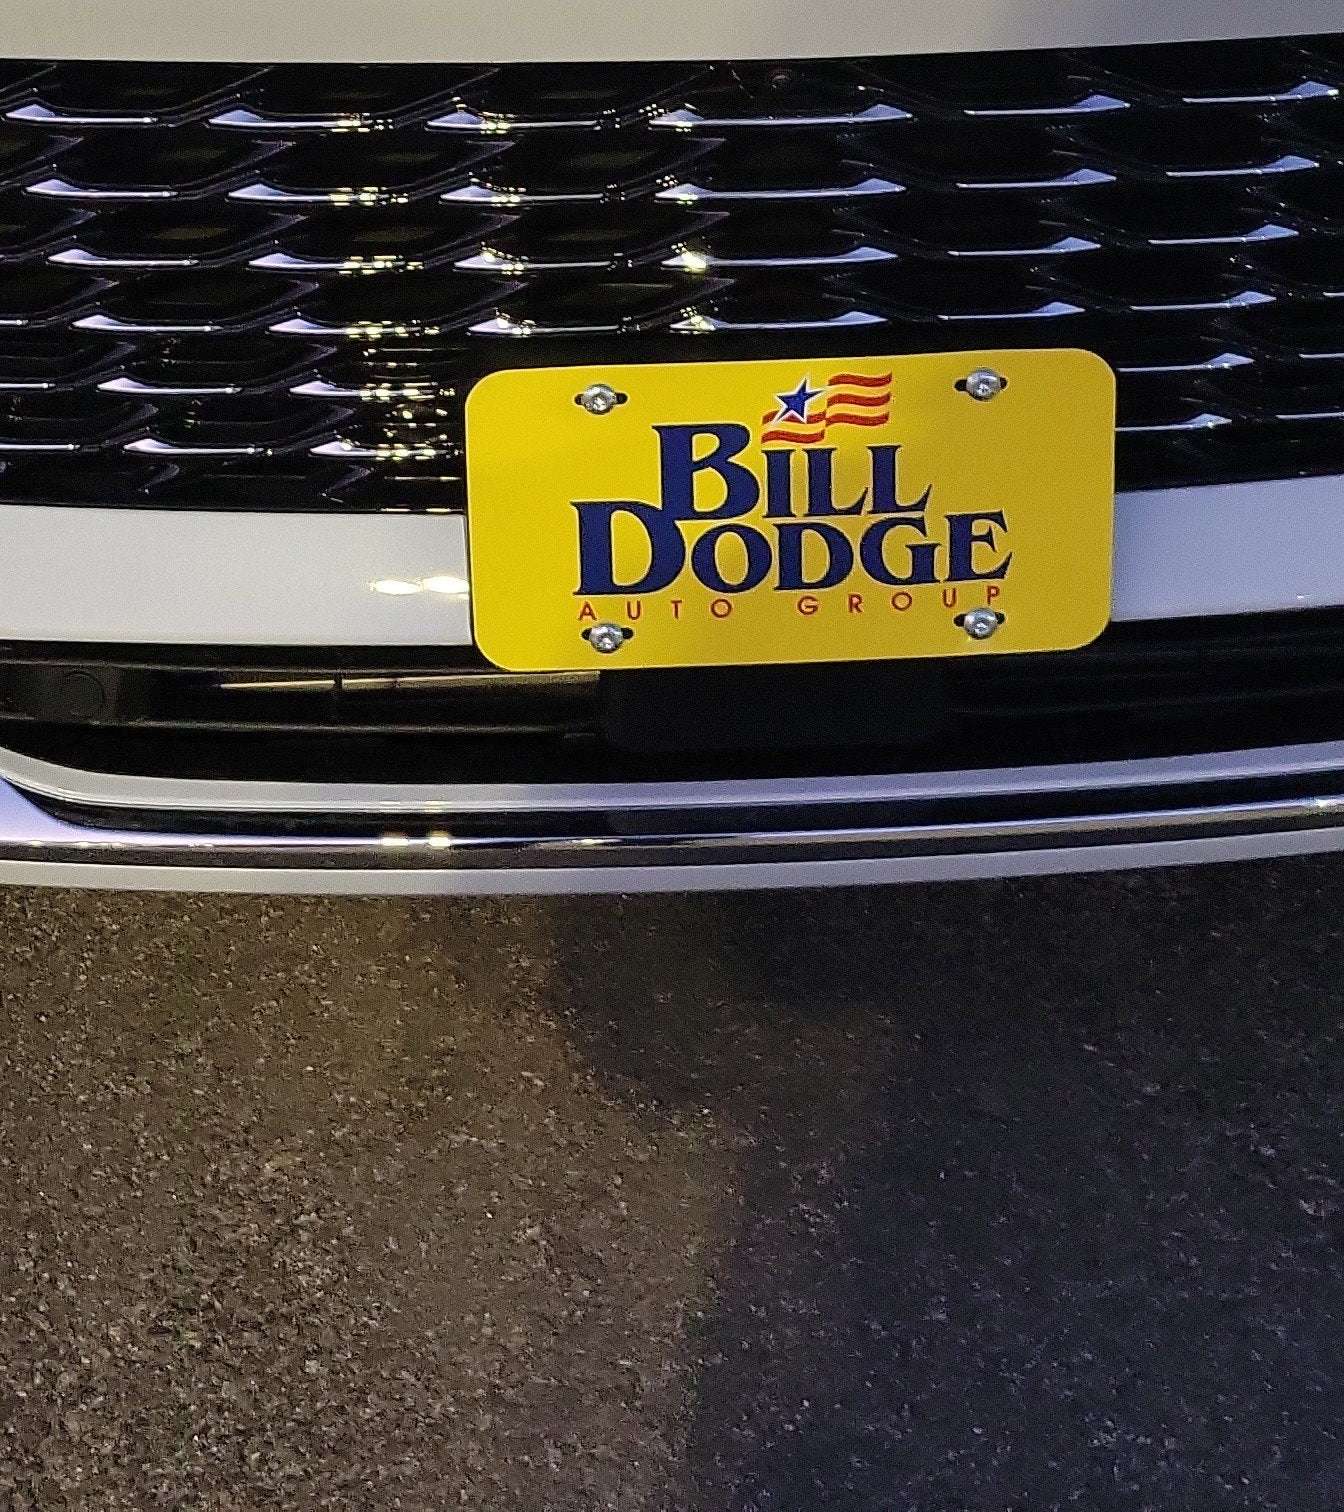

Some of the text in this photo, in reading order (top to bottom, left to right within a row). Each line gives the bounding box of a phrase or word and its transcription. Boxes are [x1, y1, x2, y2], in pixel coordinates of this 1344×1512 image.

[653, 423, 933, 520] BILL
[571, 501, 1013, 595] DODGE
[578, 586, 1001, 622] AUTO GROUP
